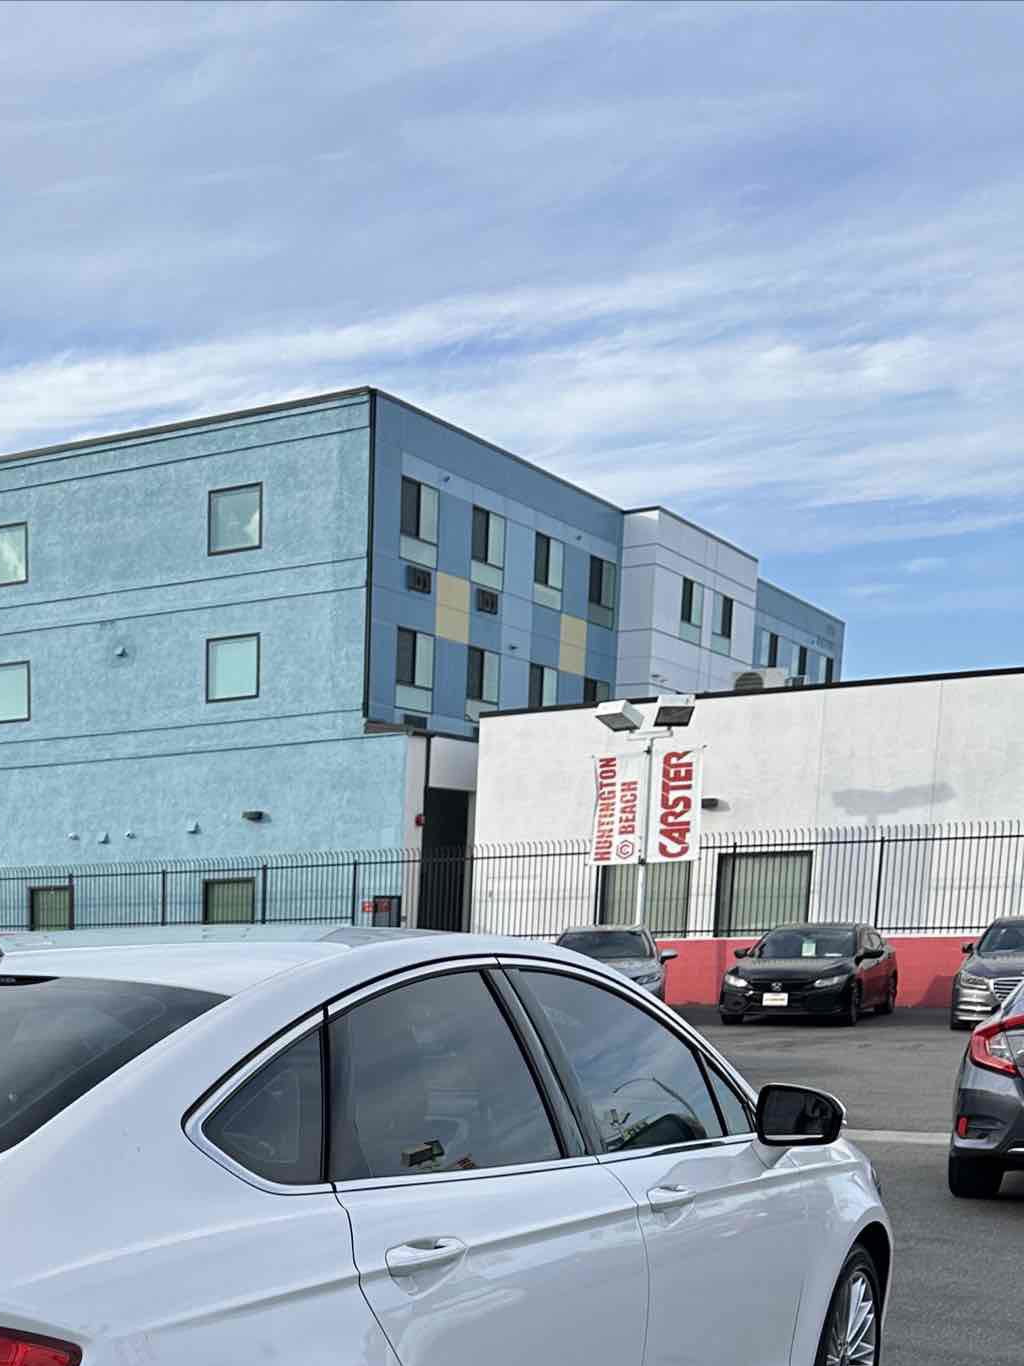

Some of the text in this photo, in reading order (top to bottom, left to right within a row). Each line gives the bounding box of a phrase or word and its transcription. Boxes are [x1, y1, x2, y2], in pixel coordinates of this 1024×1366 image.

[594, 757, 617, 861] HUNTINGTON
[618, 780, 638, 835] BEACH
[658, 750, 693, 858] CARSTER
